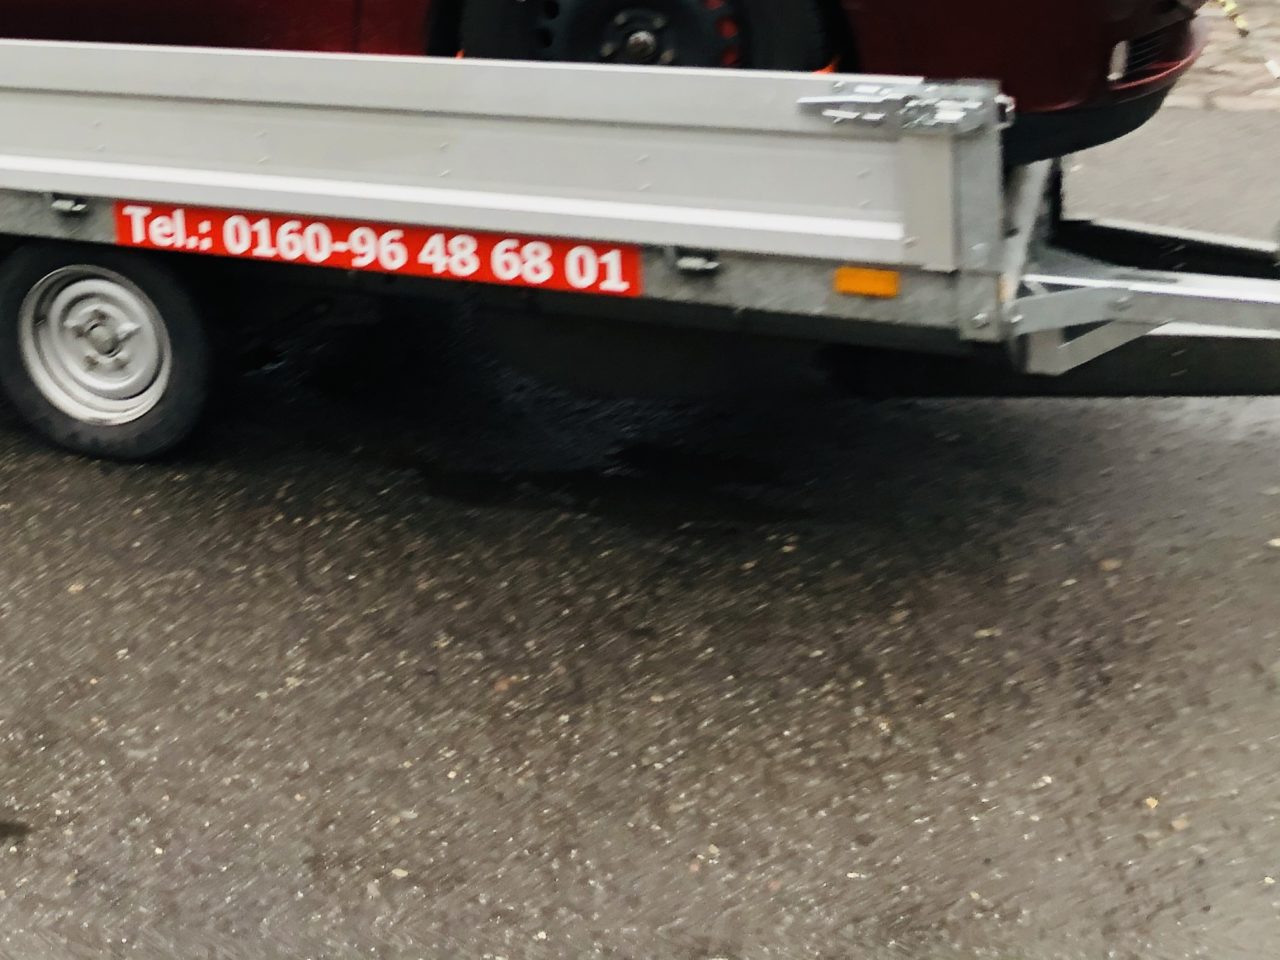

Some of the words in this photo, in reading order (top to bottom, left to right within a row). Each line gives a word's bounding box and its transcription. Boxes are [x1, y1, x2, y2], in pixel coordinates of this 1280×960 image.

[122, 205, 212, 250] Tel.:
[223, 215, 407, 269] 0160-96
[417, 234, 479, 276] 48
[491, 239, 553, 283] 68
[564, 245, 629, 291] 01
